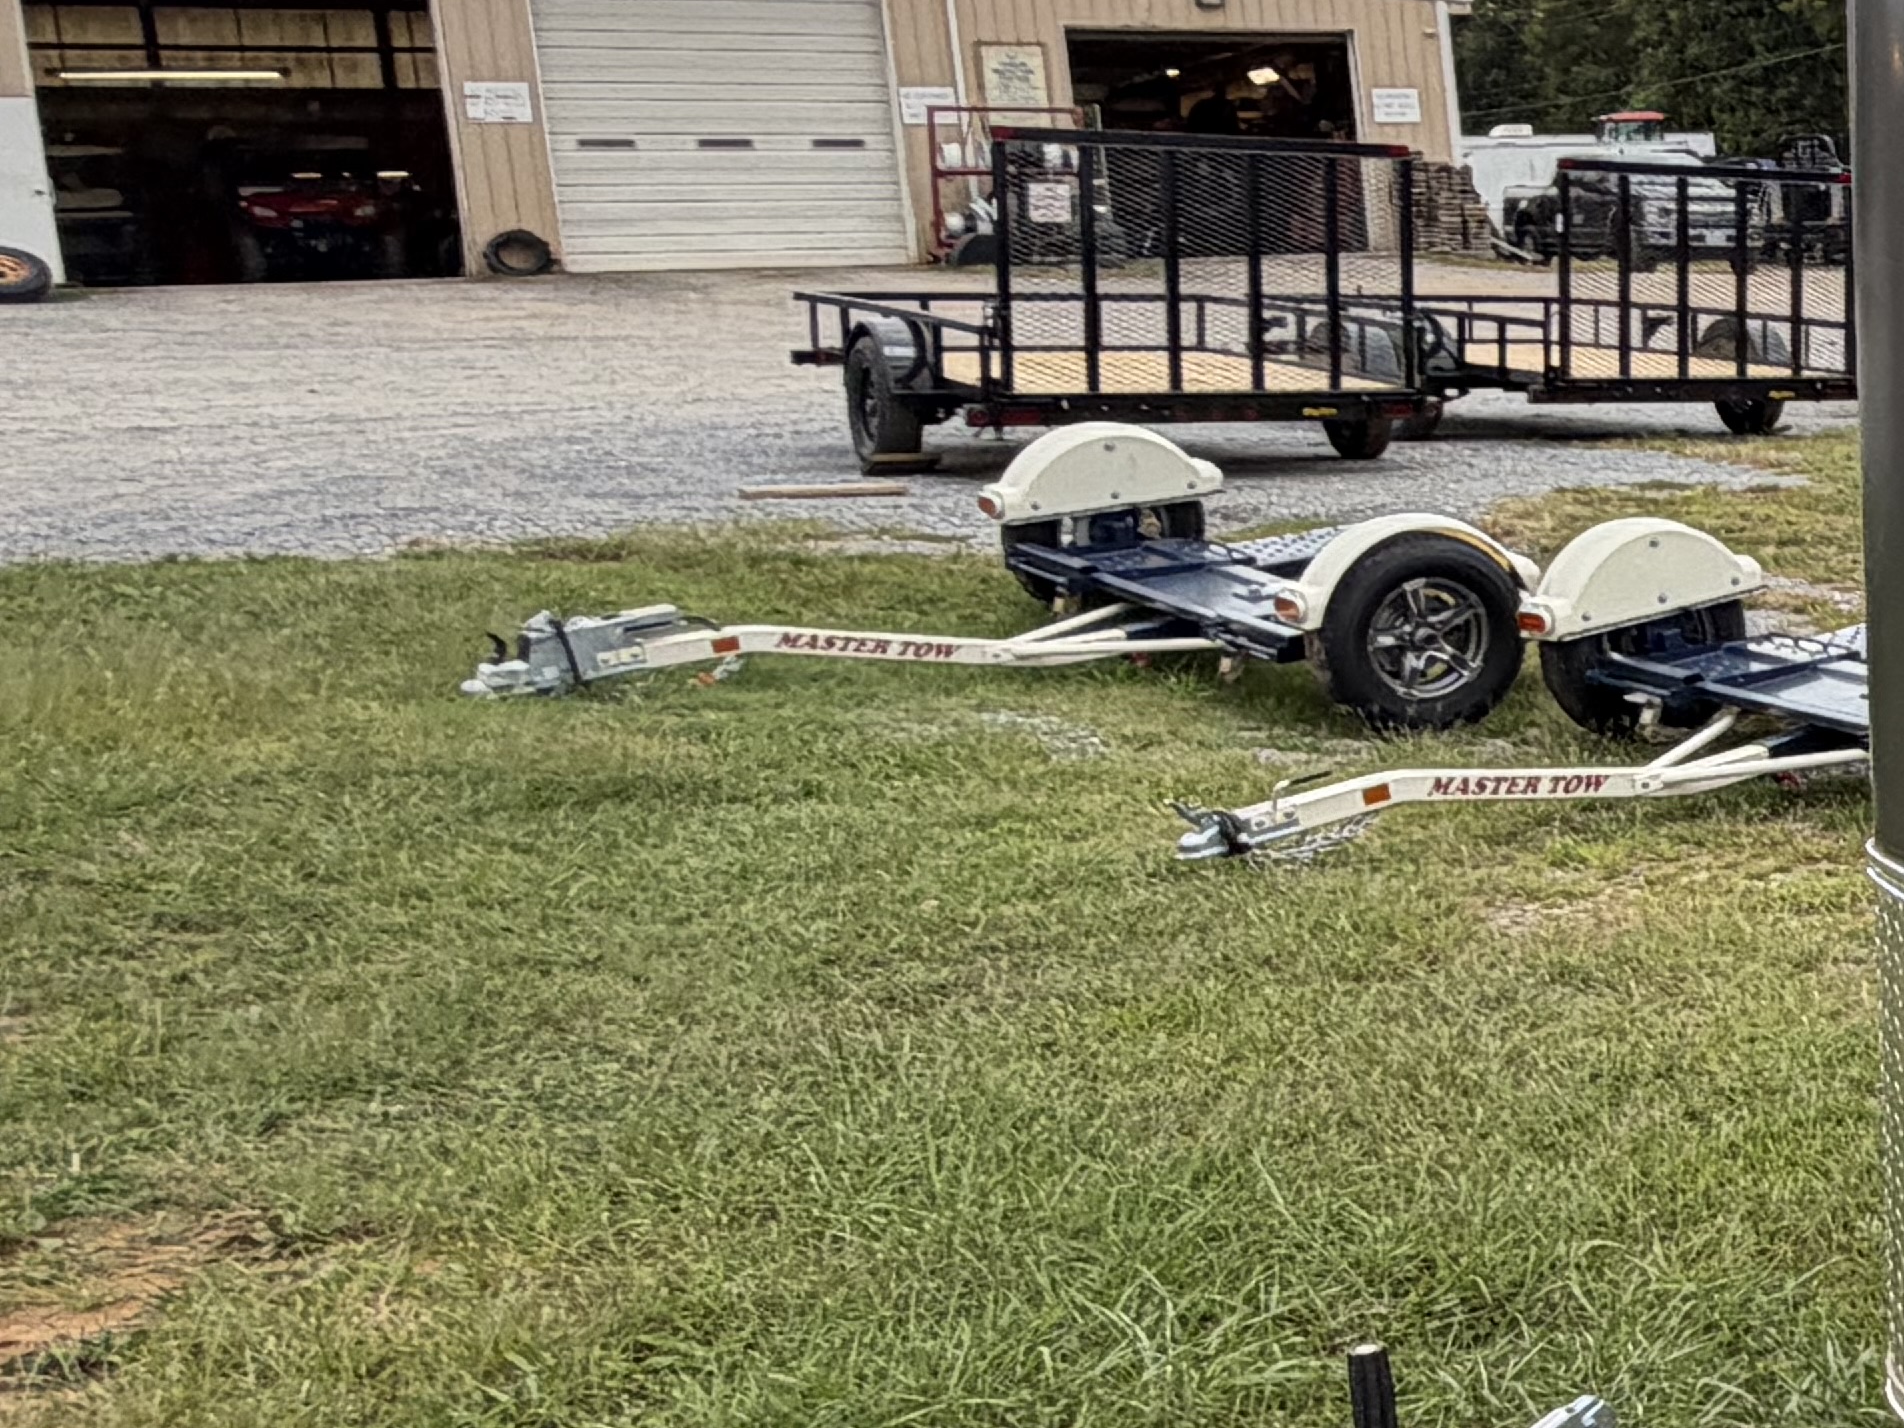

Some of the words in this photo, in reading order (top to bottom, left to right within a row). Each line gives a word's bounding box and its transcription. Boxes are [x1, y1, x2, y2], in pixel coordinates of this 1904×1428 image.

[775, 632, 893, 654] MASTER
[897, 640, 962, 658] TOW
[1426, 776, 1542, 797] MASTER
[1547, 774, 1610, 795] TOW
